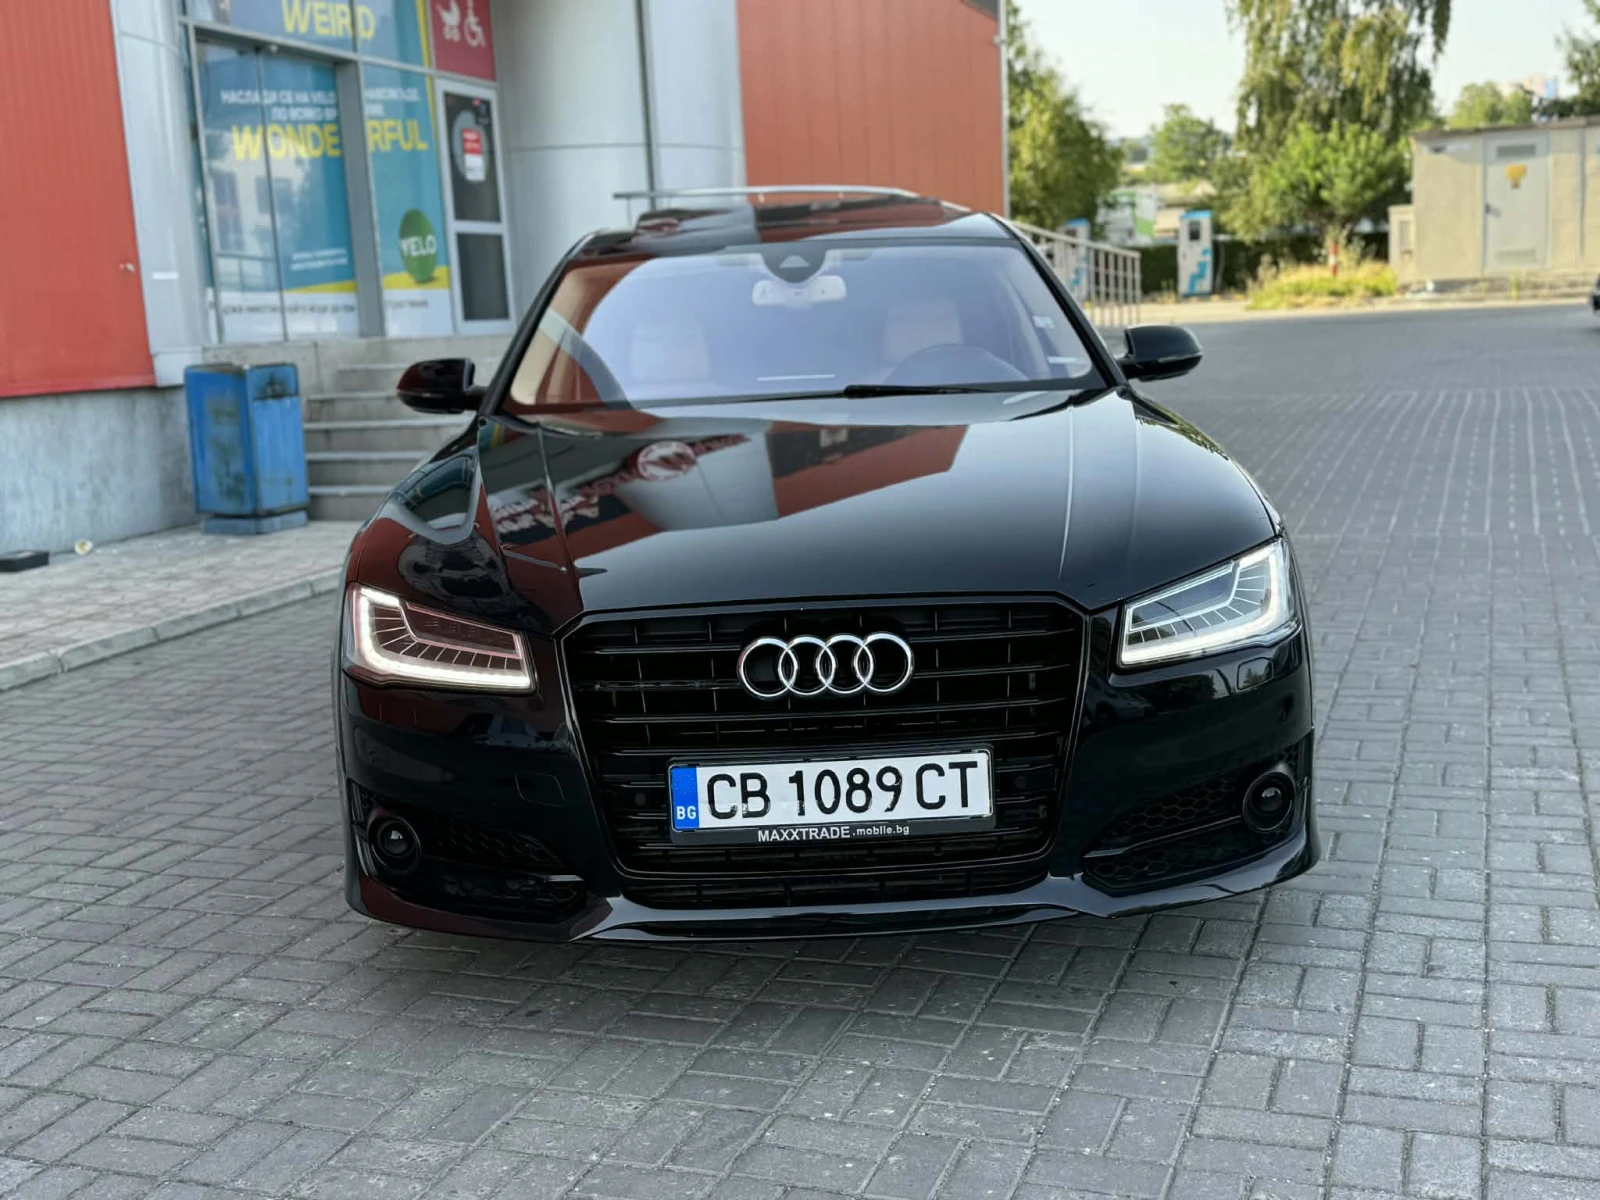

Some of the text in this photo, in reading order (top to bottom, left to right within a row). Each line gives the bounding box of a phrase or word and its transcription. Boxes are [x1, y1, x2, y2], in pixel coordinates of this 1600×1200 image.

[281, 0, 376, 40] WEIRD
[707, 760, 979, 820] CB 1089 CT
[676, 805, 697, 820] BG
